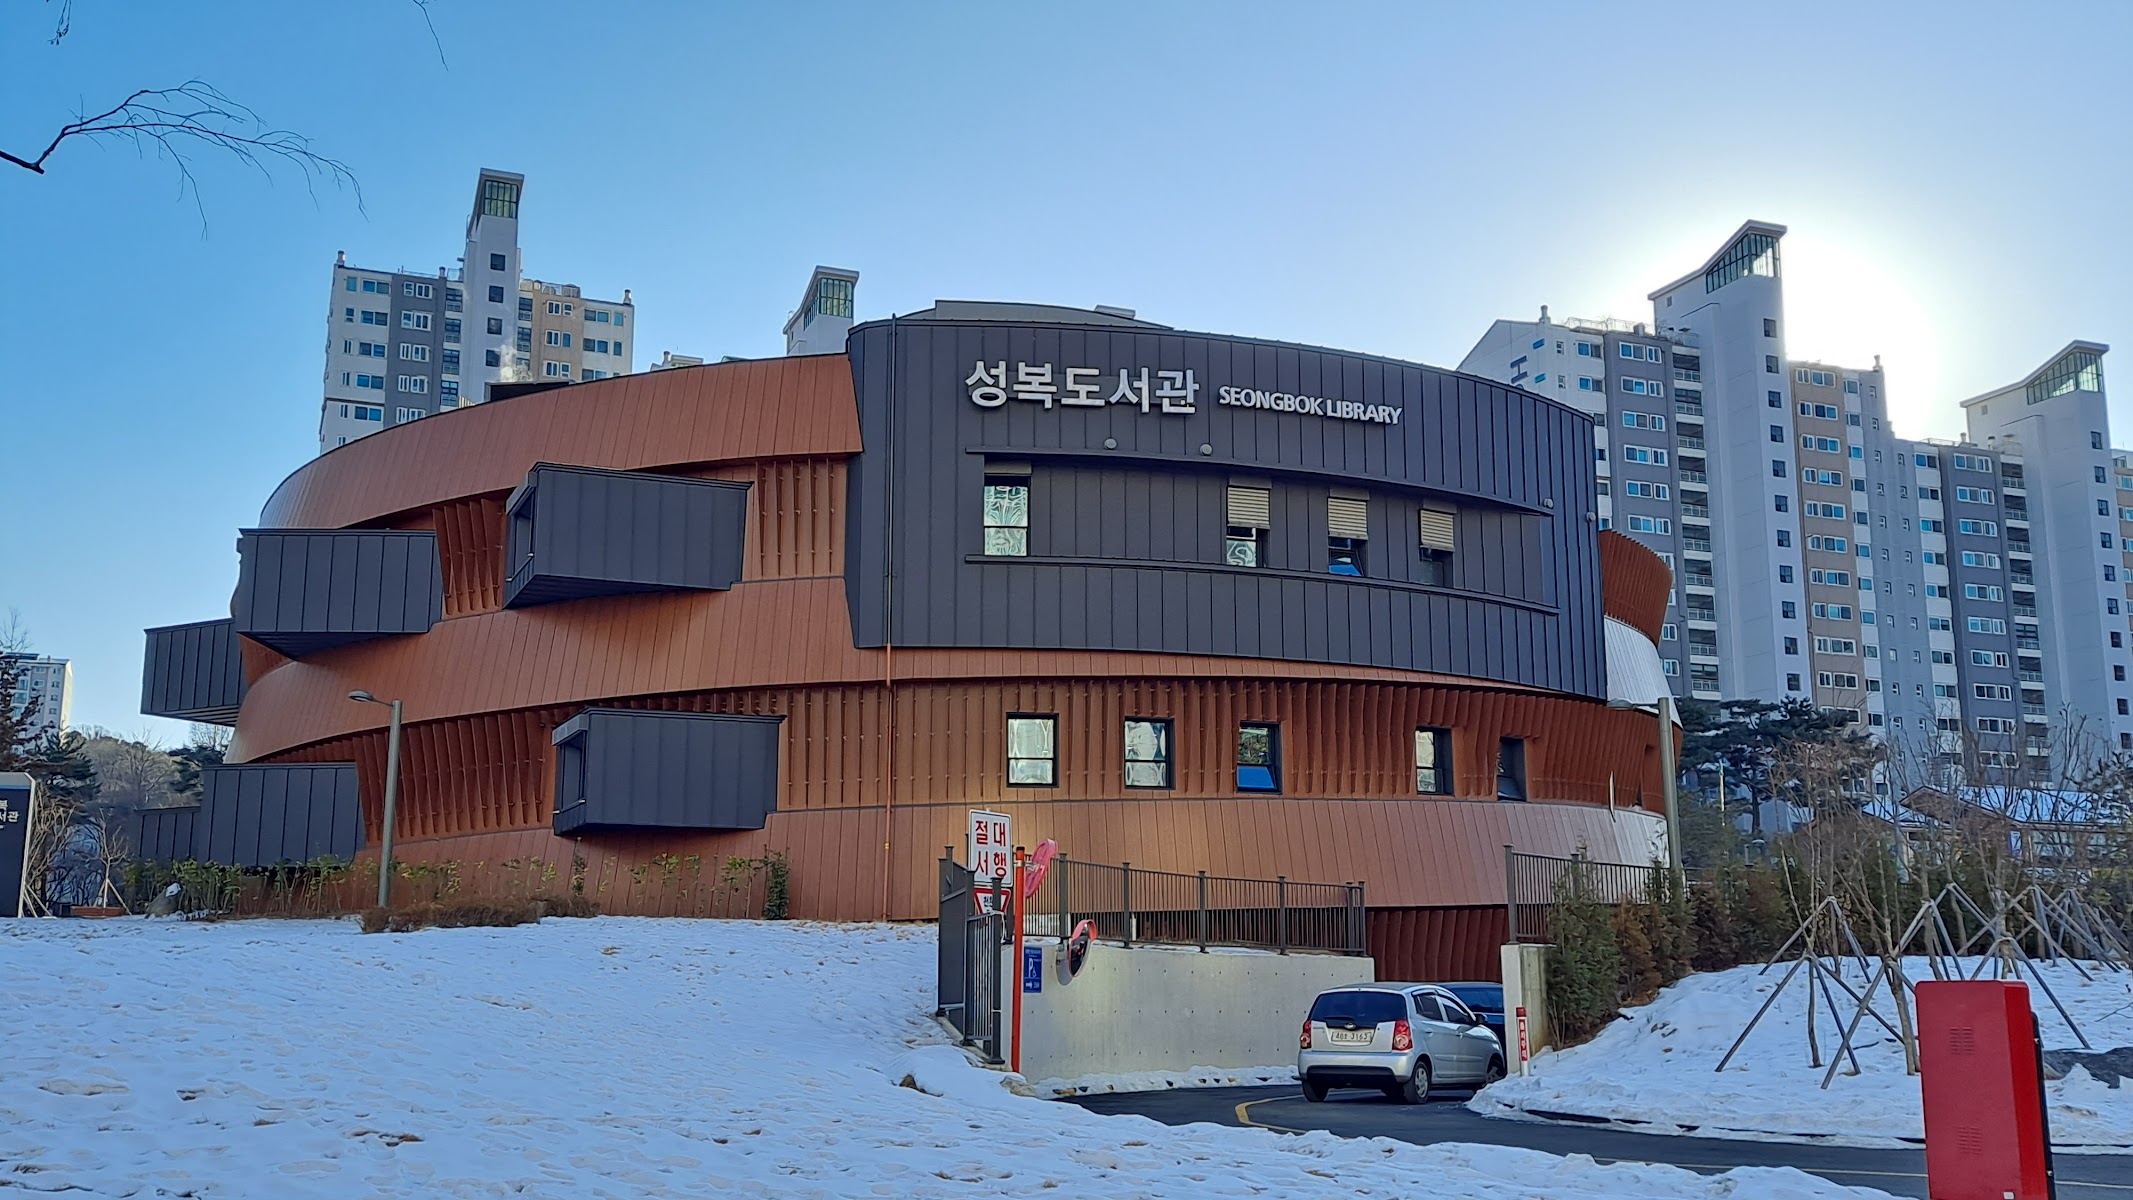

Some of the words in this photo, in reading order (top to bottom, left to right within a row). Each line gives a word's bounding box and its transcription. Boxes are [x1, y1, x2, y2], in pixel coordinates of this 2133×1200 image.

[965, 360, 1200, 414] 성복도서관
[1219, 386, 1324, 416] SEONGBOK
[1326, 399, 1403, 425] LIBRARY
[975, 820, 1006, 847] 절대
[975, 851, 1007, 878] 서행
